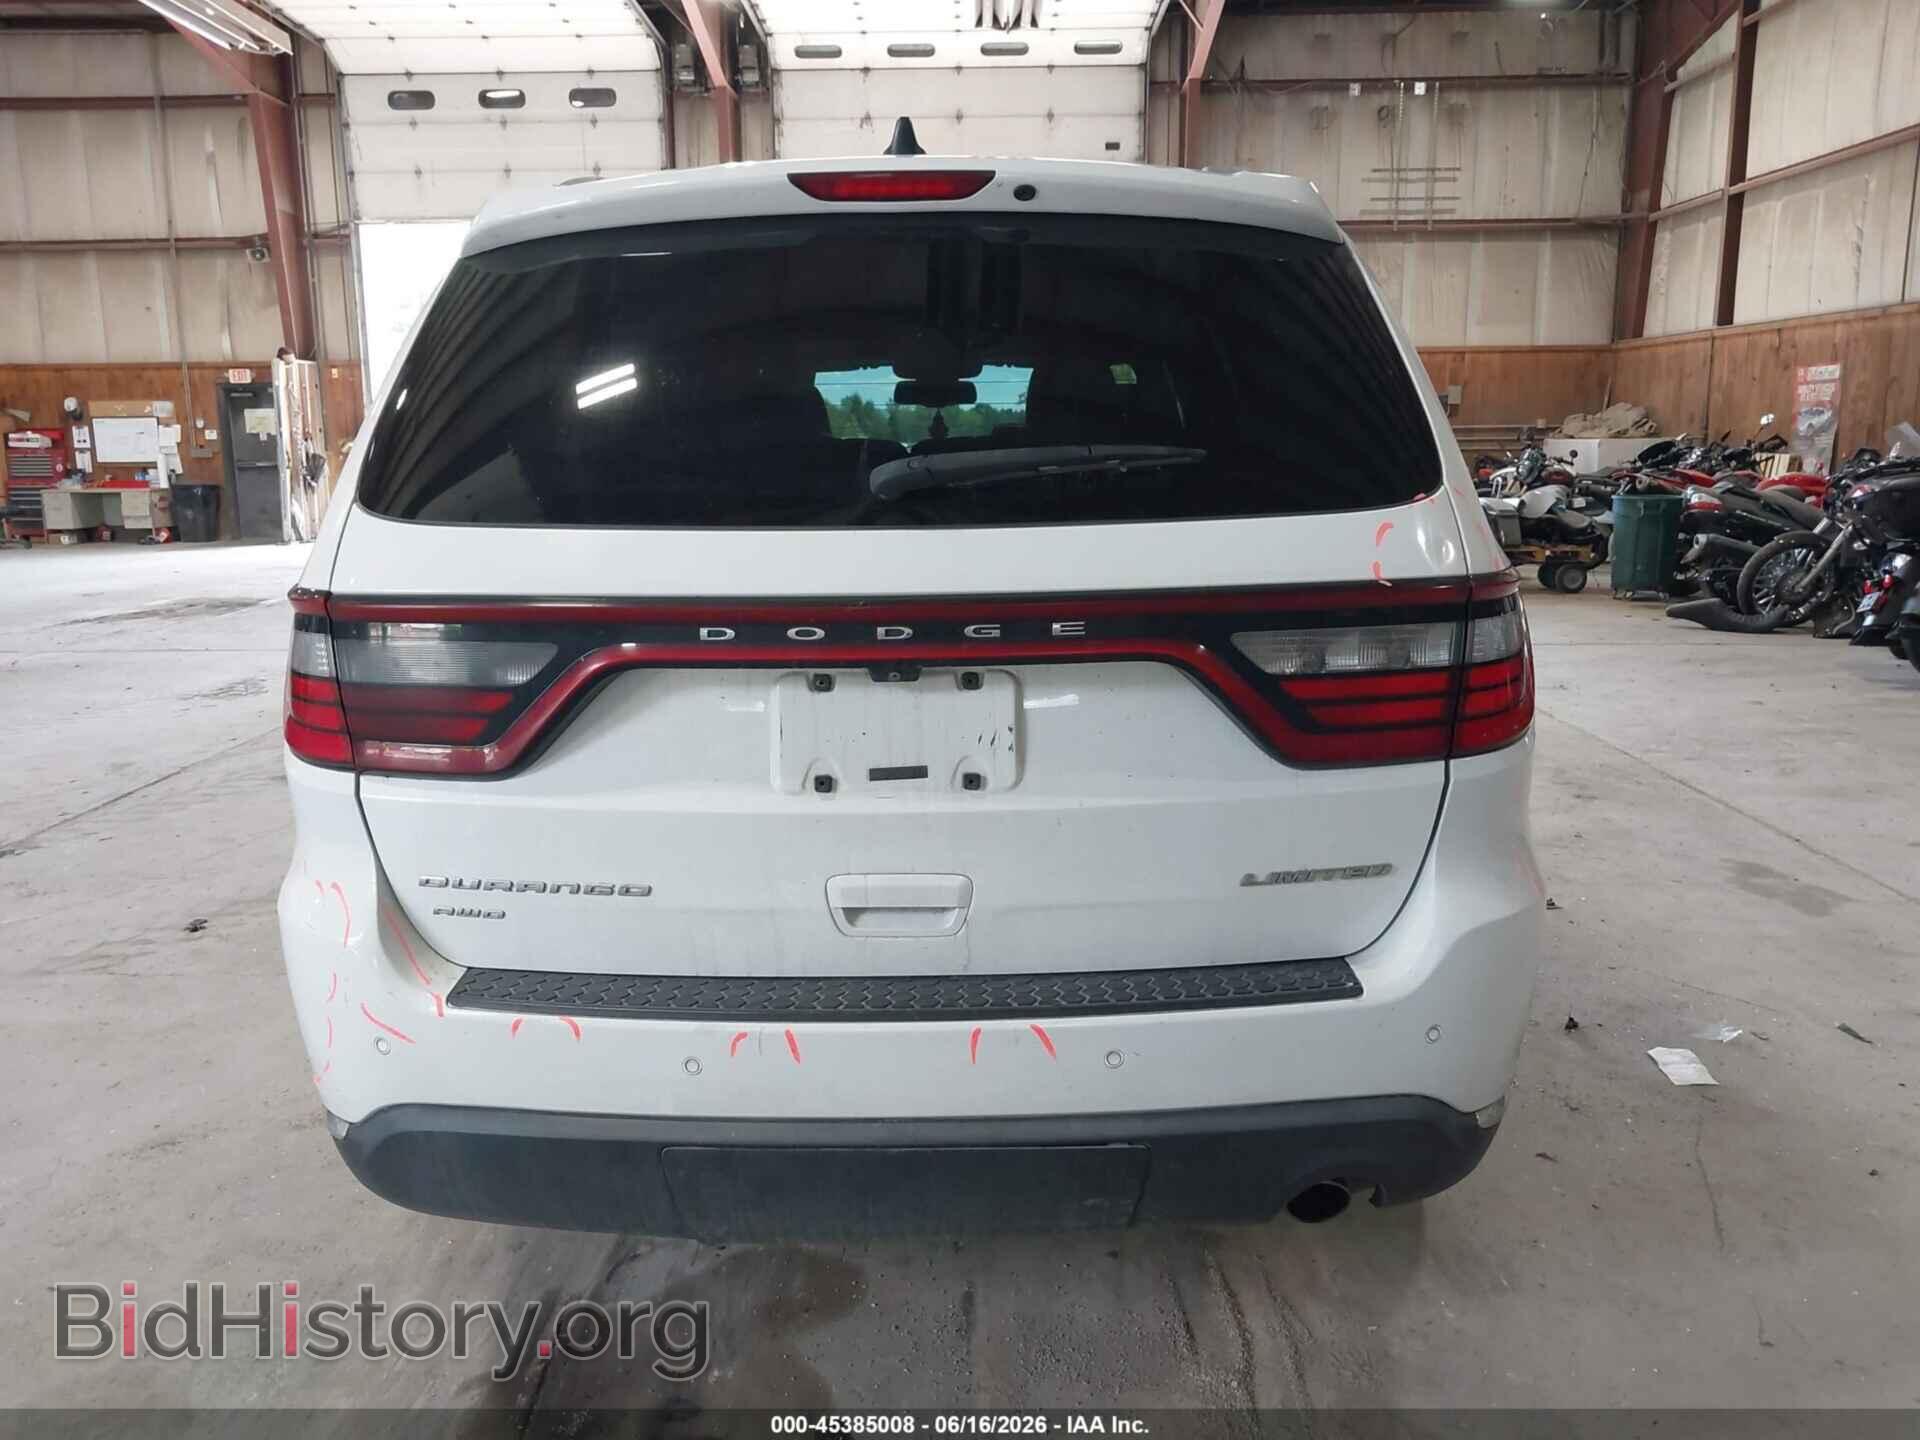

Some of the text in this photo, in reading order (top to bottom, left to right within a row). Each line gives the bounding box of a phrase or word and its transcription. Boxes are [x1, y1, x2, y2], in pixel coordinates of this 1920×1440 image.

[699, 621, 1086, 641] DODGE
[1240, 863, 1393, 887] LIMITED
[418, 875, 653, 897] DURANGO
[433, 906, 506, 919] AWD
